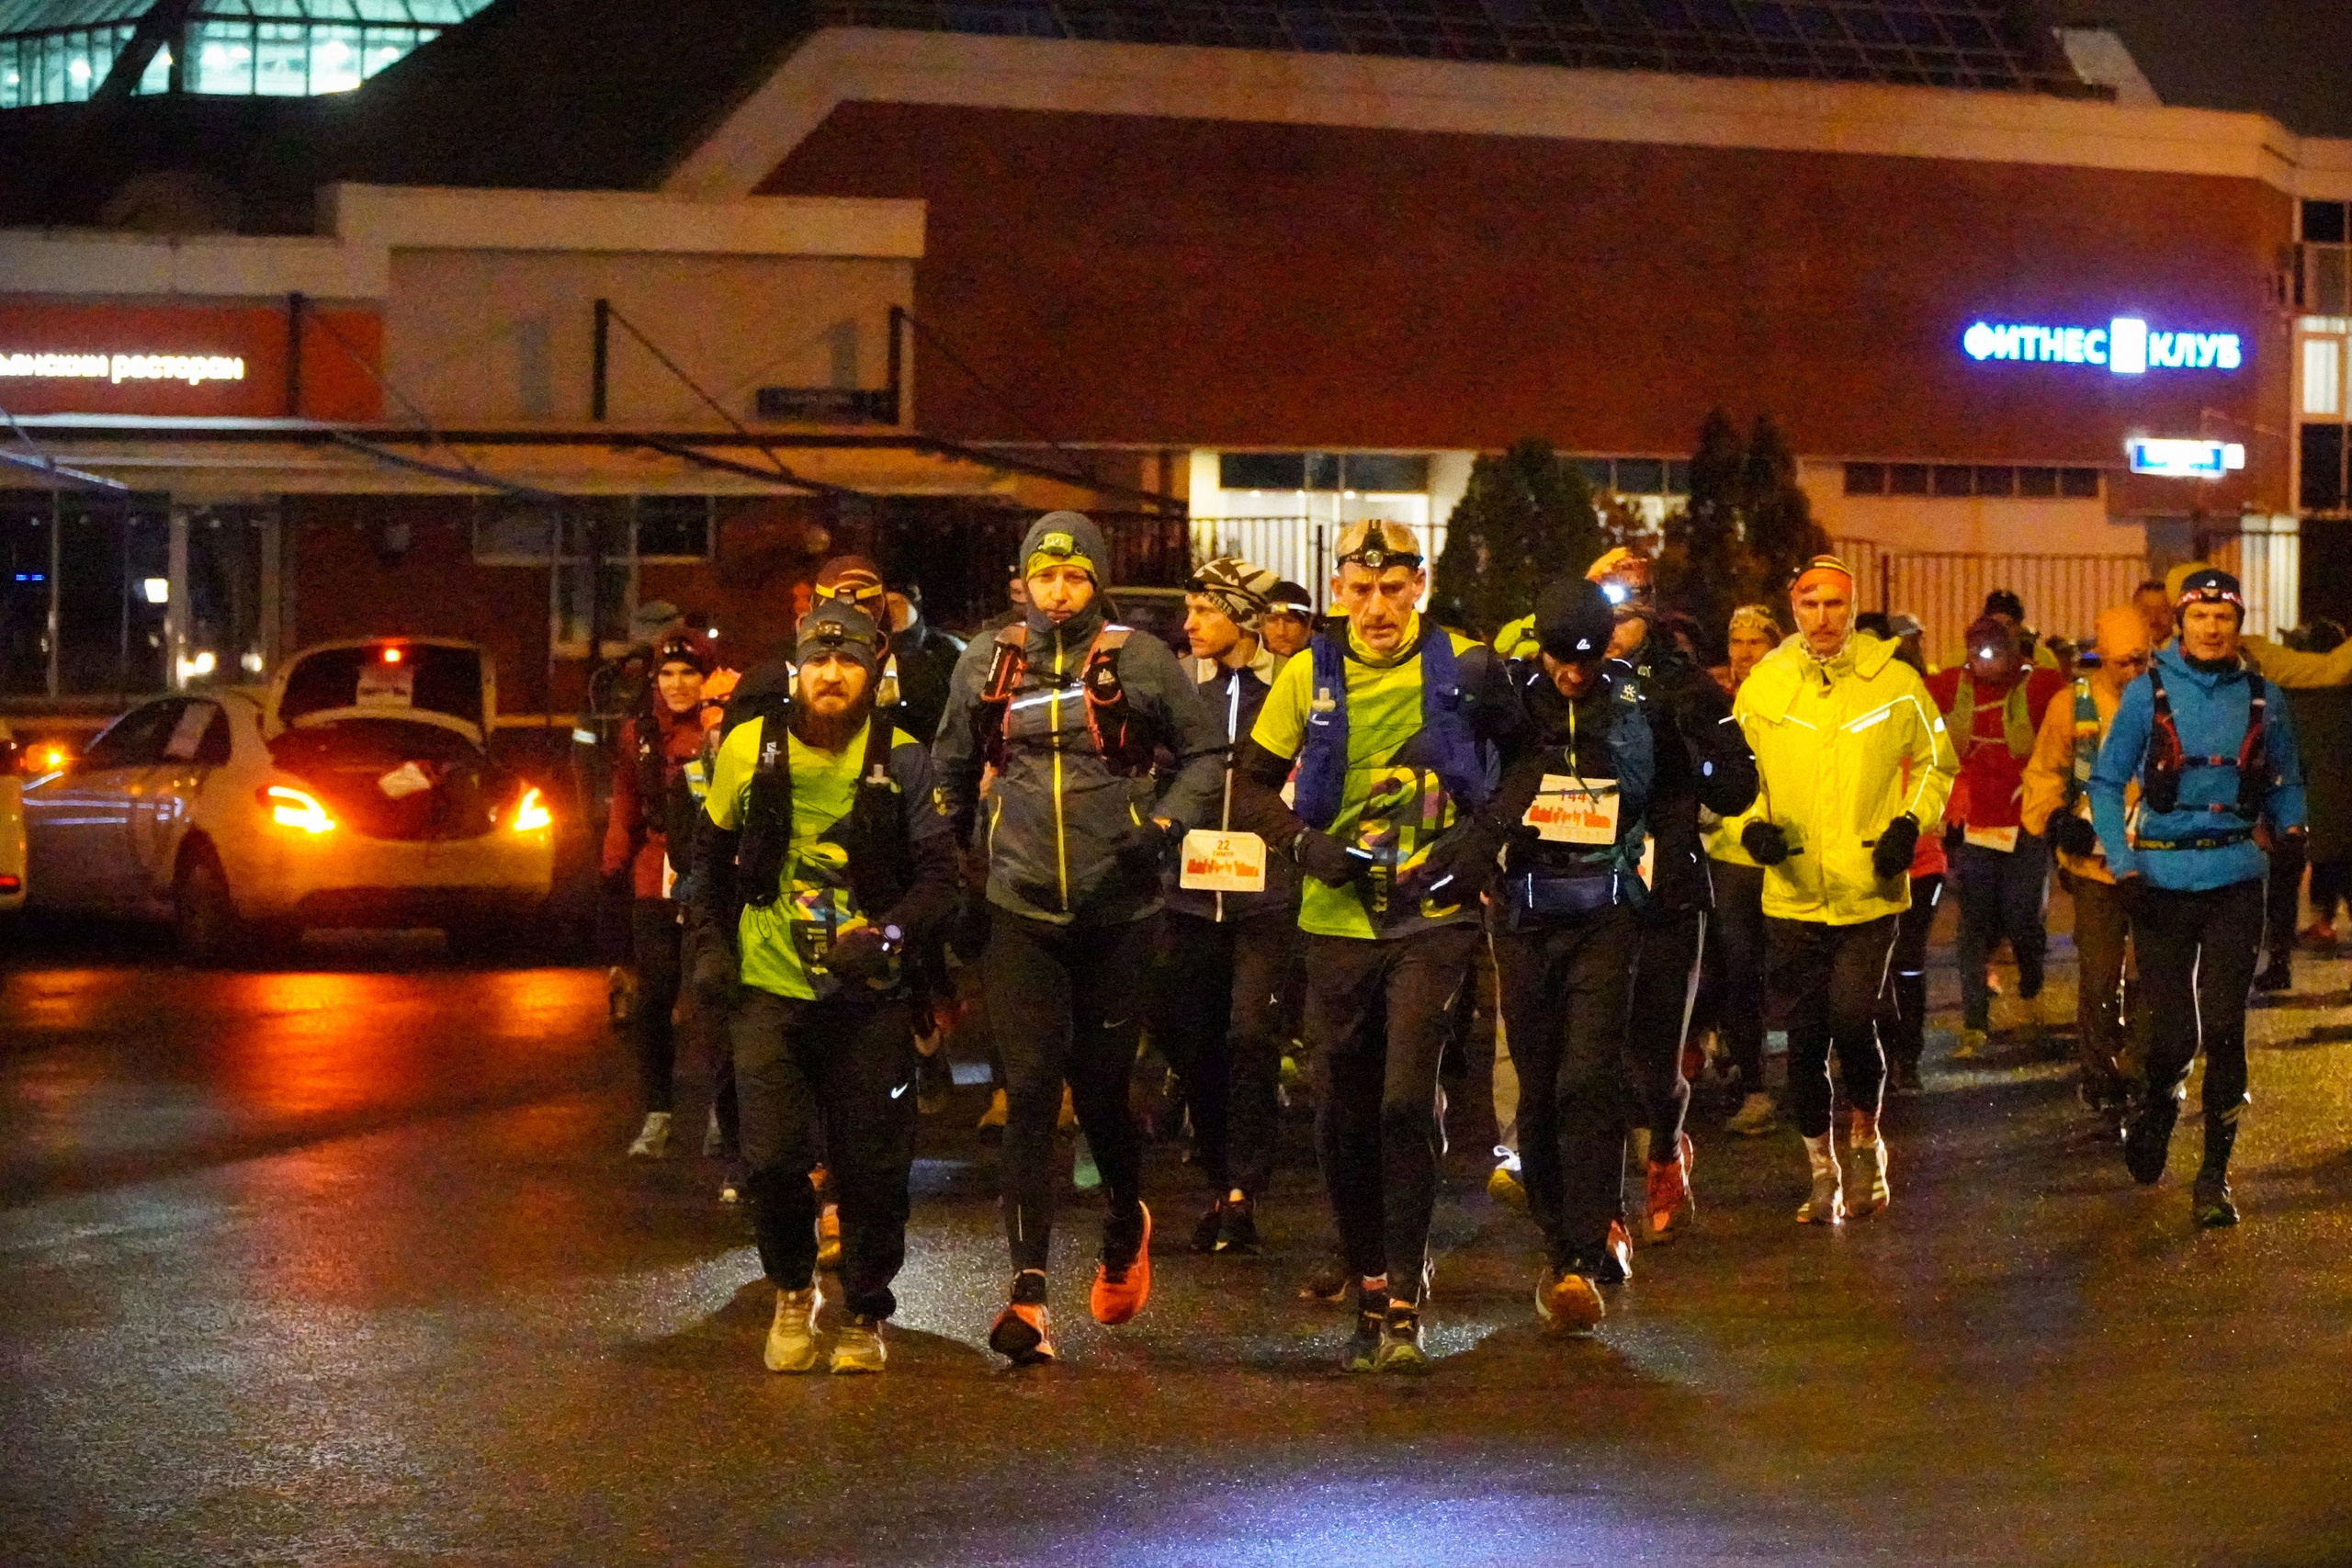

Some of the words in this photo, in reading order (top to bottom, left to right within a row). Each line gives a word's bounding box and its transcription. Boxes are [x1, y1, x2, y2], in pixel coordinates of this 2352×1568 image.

[1963, 322, 2107, 364] ФИТНЕС
[2148, 332, 2241, 369] КЛУБ
[111, 355, 244, 385] ресторан
[1217, 840, 1230, 851] 22
